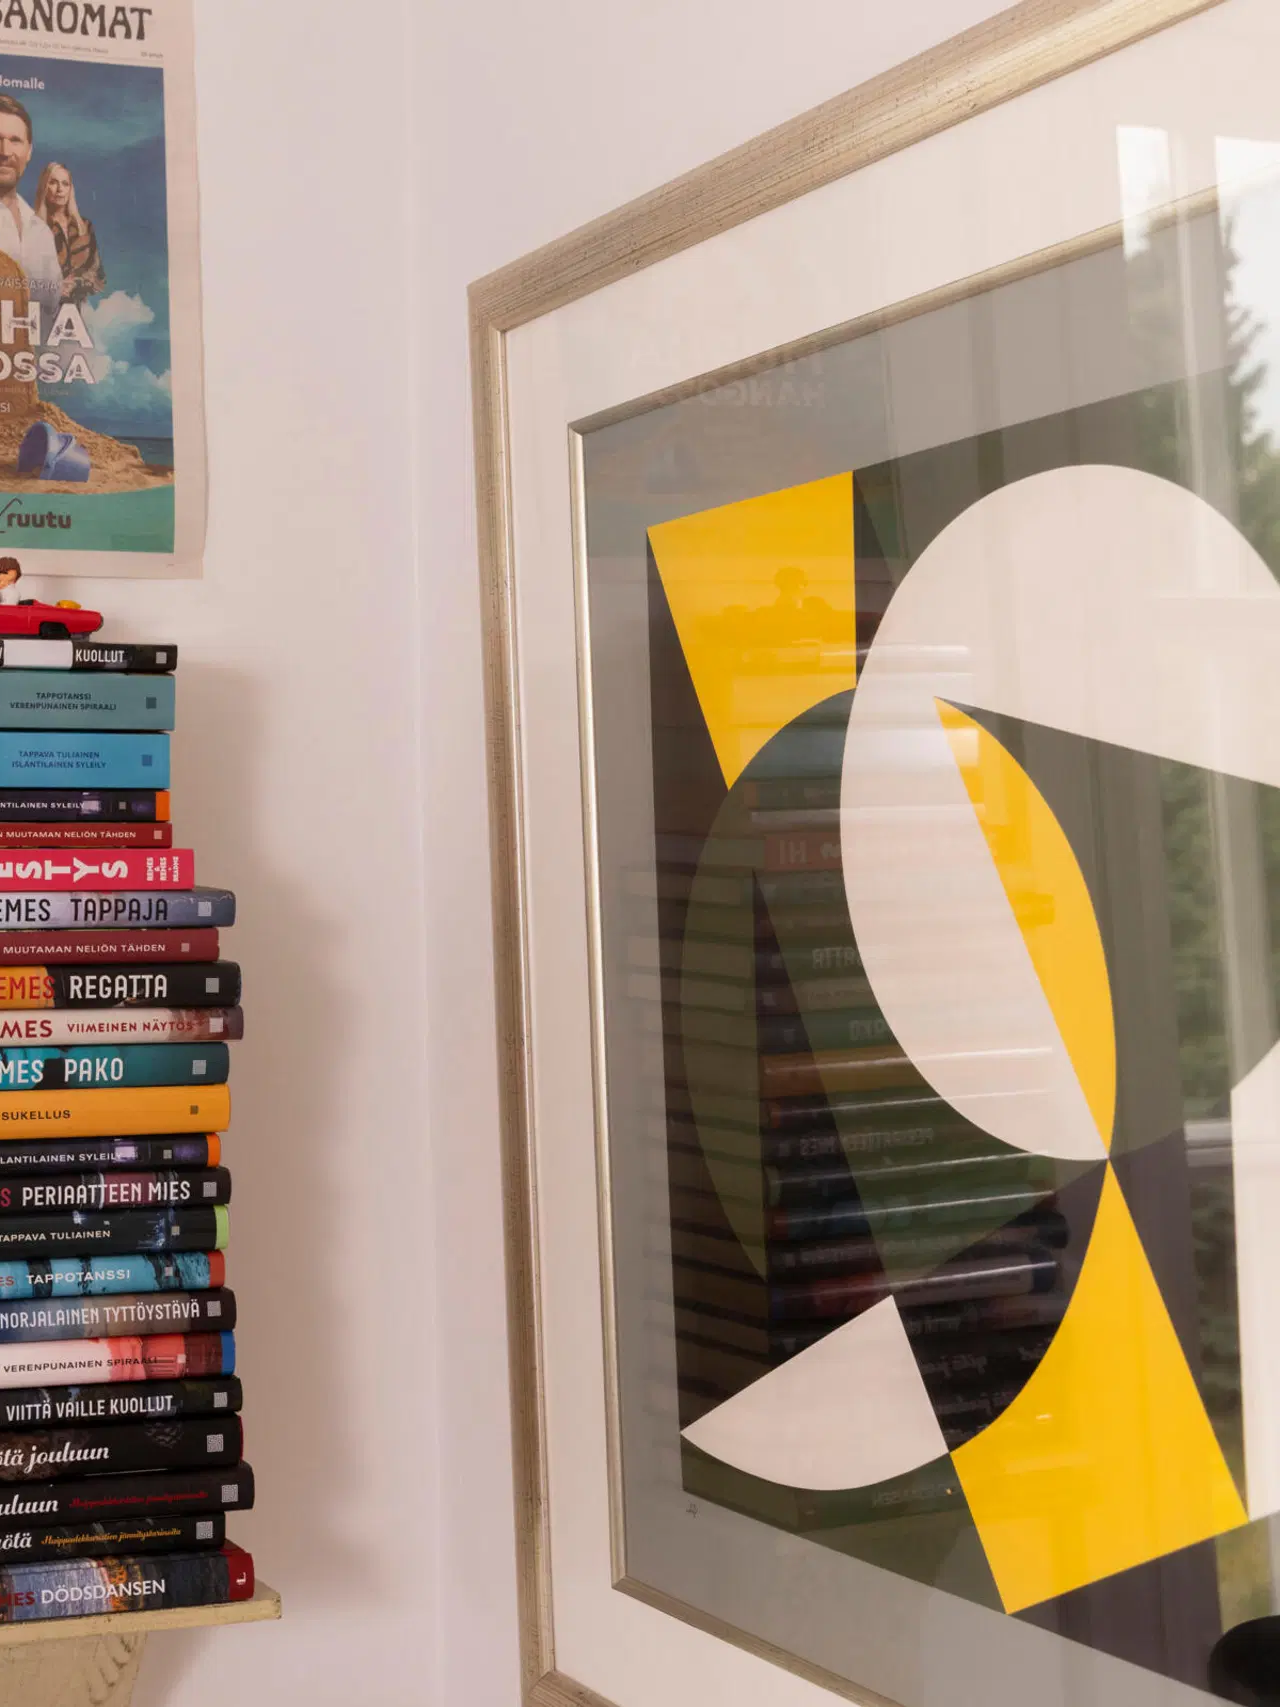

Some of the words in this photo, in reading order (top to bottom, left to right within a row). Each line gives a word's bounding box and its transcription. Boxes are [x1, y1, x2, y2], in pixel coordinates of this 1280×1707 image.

[7, 511, 72, 529] ruutu
[75, 649, 125, 663] KUOLLUT
[35, 691, 92, 701] TAPPOTANSSI
[9, 702, 79, 711] VERENPUNAINEN
[80, 703, 117, 711] SPIRAALI
[18, 750, 54, 759] TAPPAVA
[56, 750, 100, 759] TULIAINEN
[11, 760, 73, 769] ISLANTILAINEN
[75, 760, 107, 769] SYLEILY
[50, 801, 85, 809] SYLEILY
[64, 829, 98, 839] NELIÖN
[99, 829, 137, 839] TÄHDEN
[71, 897, 169, 921] TAPPAJA
[3, 944, 73, 955] MUUTAMAN
[75, 942, 118, 954] NELIÖN
[121, 941, 166, 953] TÄHDEN
[69, 974, 167, 999] REGATTA
[67, 1021, 138, 1034] VIIMEINEN
[142, 1017, 194, 1032] NÄYTÖS
[64, 1058, 124, 1082] PAKO
[1, 1109, 71, 1121] SUKELLUS
[78, 1152, 122, 1162] SYLEILY
[21, 1182, 142, 1209] PERIAATTEEN
[147, 1181, 191, 1201] MIES
[49, 1230, 111, 1241] TULIAINEN
[25, 1269, 130, 1285] TAPPOTANSSI
[0, 1307, 99, 1330] NORJALAINEN
[104, 1300, 200, 1323] TYTTÖYSTÄVÄ
[3, 1360, 103, 1373] VERENPUNAINEN
[106, 1357, 158, 1368] SPIRAALI
[6, 1401, 52, 1422] VIITTÄ
[55, 1400, 106, 1420] VAILLE
[110, 1395, 174, 1416] KUOLLUT
[26, 1442, 110, 1474] jouluun
[41, 1579, 166, 1605] DÖDSDANSEN
